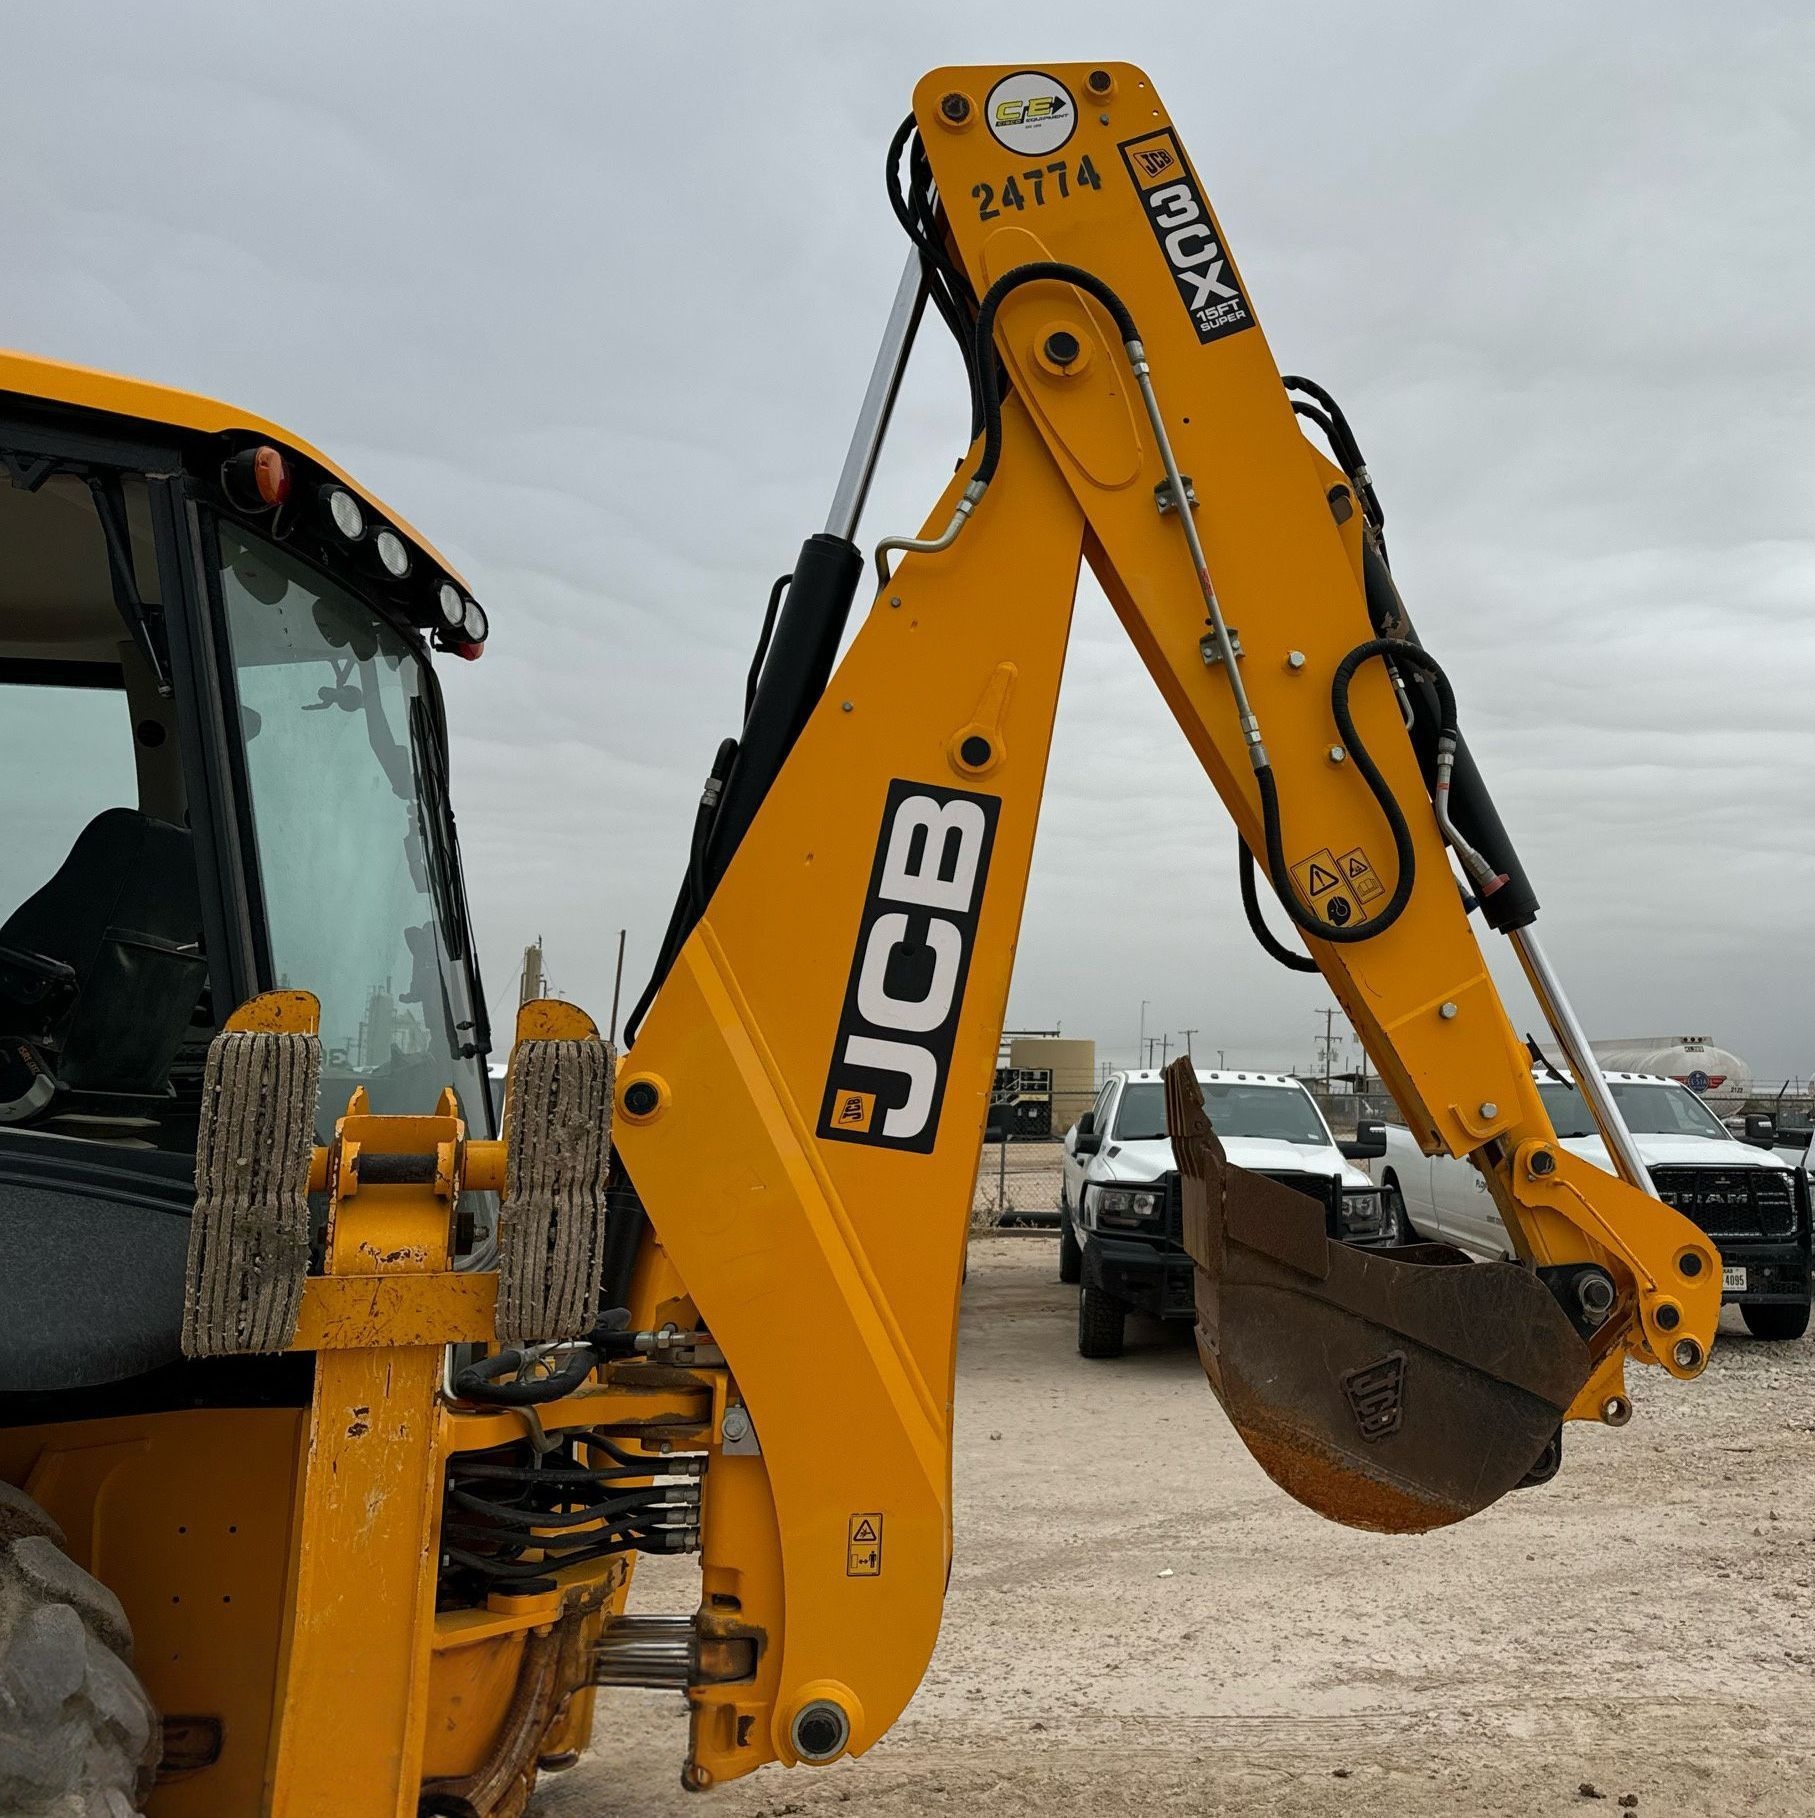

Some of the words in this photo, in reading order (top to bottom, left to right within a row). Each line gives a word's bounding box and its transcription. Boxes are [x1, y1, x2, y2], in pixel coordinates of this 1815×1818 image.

[1139, 149, 1174, 176] JCB
[971, 154, 1102, 222] 24774
[1149, 183, 1240, 311] 3CX
[1196, 298, 1240, 322] 15FT
[1200, 310, 1246, 332] SUPER
[843, 795, 986, 1139] JCB
[842, 1098, 862, 1119] JCB
[1725, 1274, 1745, 1286] 4095
[1352, 1370, 1398, 1431] JCB
